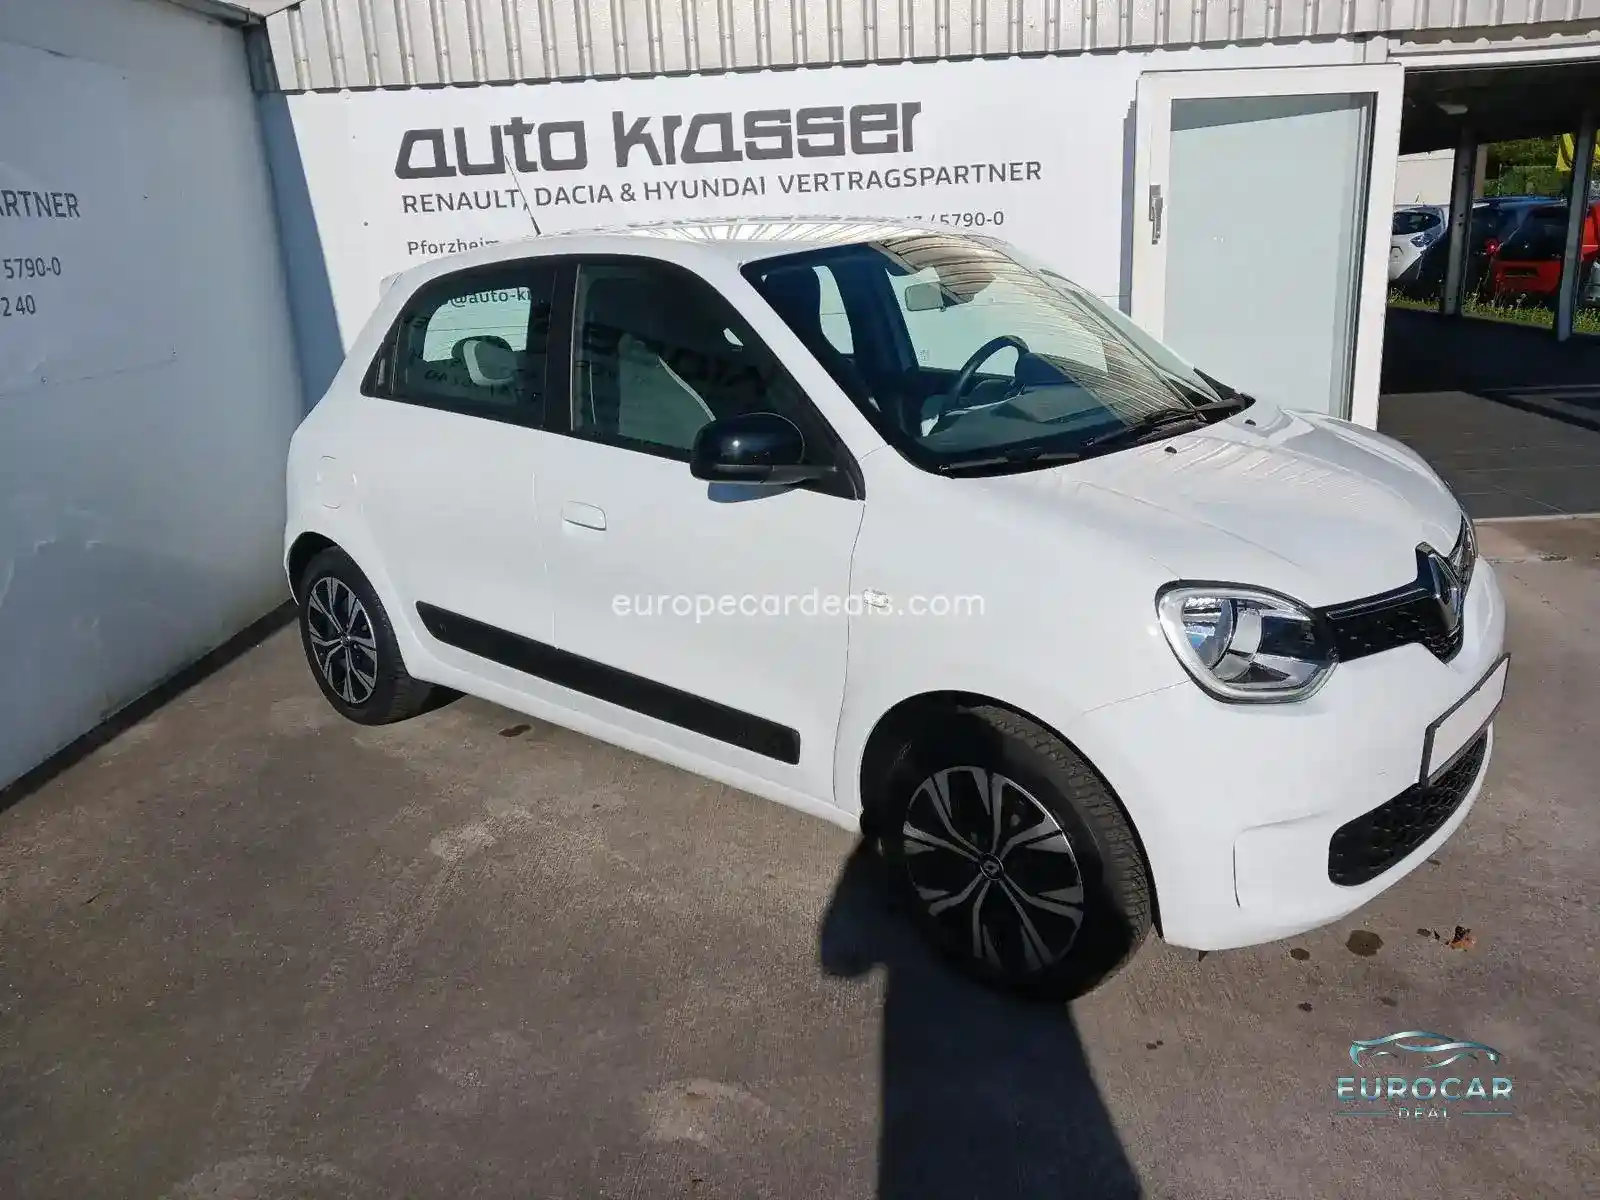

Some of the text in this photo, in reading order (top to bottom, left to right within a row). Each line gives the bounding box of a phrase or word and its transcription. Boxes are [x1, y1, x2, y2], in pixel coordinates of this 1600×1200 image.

[395, 101, 922, 179] auto krasser
[534, 184, 613, 207] DACIA
[620, 183, 636, 202] &
[644, 175, 766, 200] HYUNDAI
[778, 161, 1042, 194] VERTRAGSPARTNER
[0, 189, 80, 218] RTNER
[407, 237, 500, 255] Pforzhei
[3, 257, 61, 278] 5790-0
